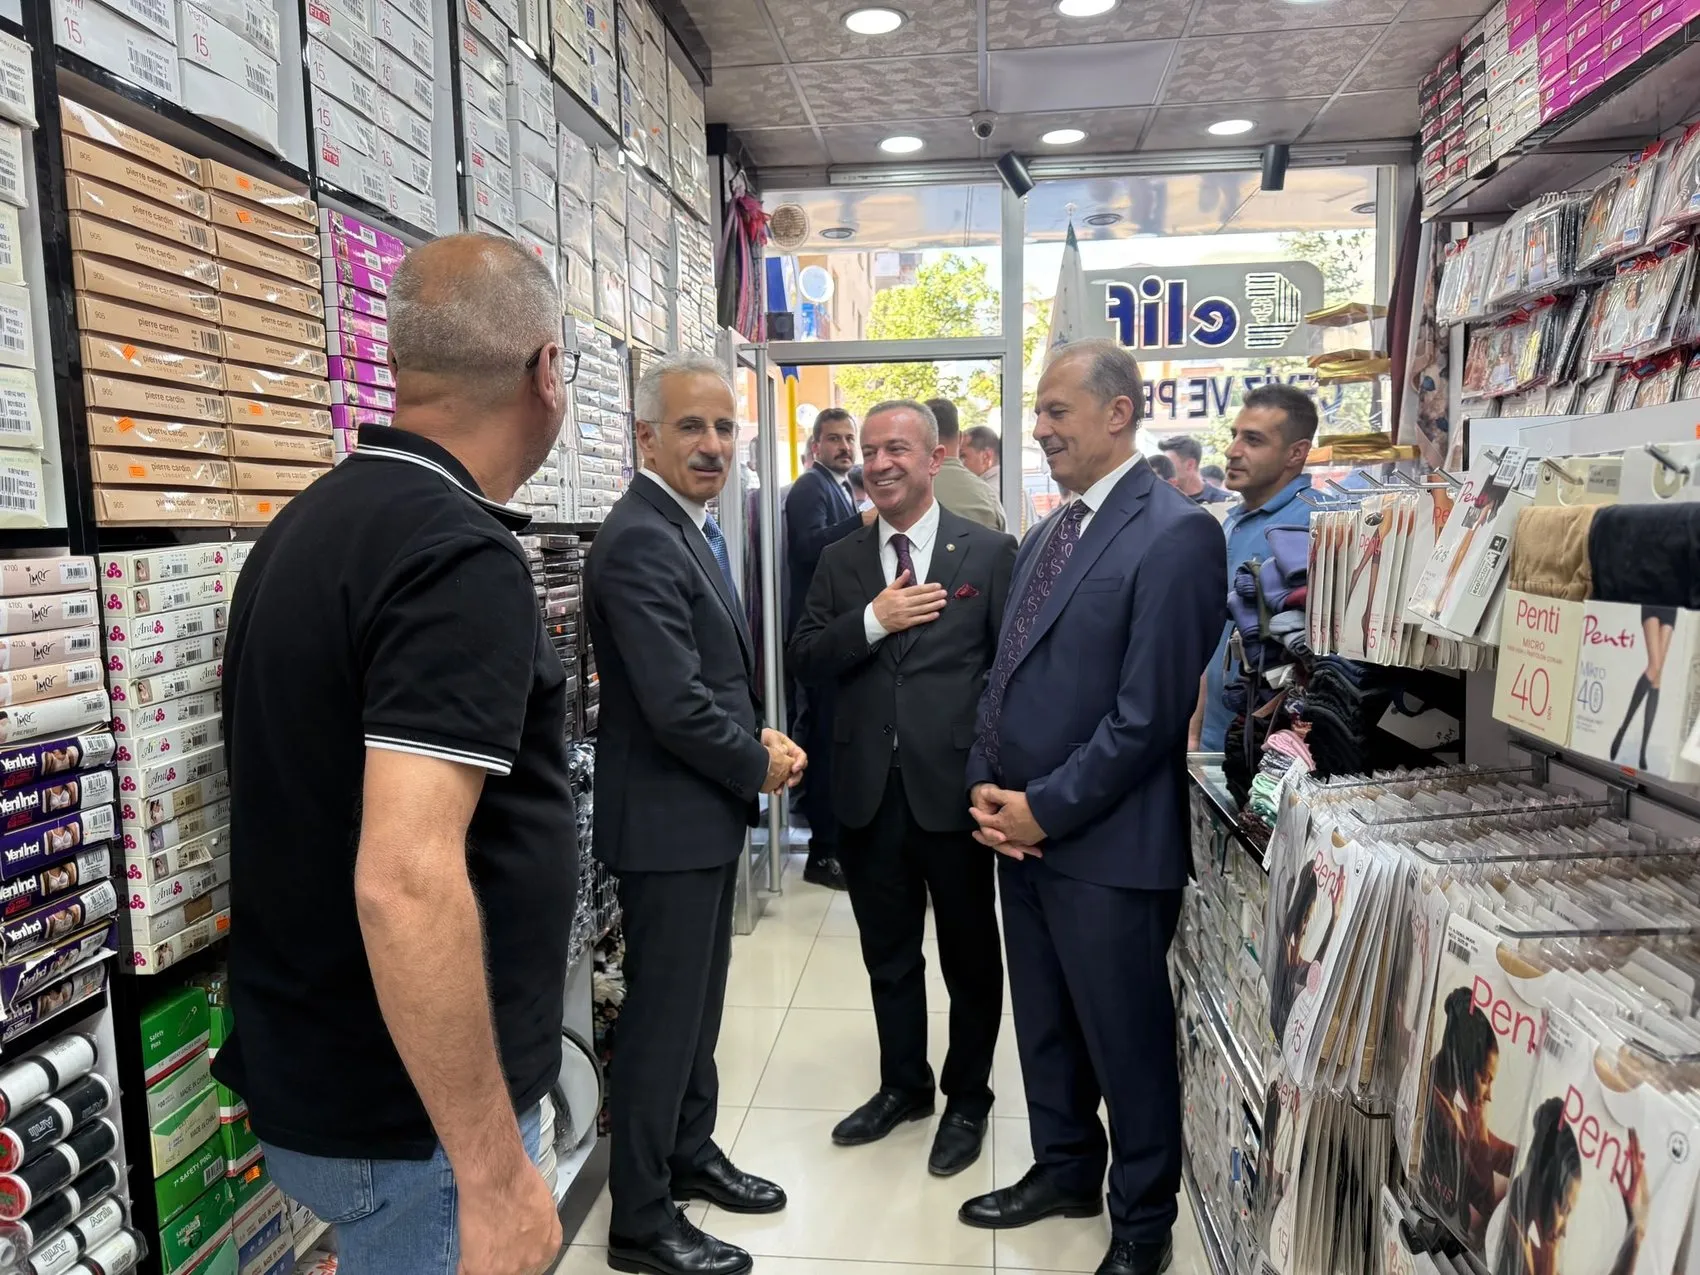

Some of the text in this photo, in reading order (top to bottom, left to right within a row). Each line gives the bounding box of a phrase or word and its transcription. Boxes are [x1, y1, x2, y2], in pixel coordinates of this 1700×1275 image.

[64, 16, 82, 44] 15
[382, 18, 391, 37] 15
[193, 33, 209, 57] 15
[314, 61, 325, 80] 15
[382, 63, 391, 81] 15
[317, 107, 331, 127] 15
[382, 150, 392, 167] 15
[126, 167, 168, 189] pierre cardin
[389, 194, 398, 210] 15
[132, 205, 174, 225] pierre cardin
[135, 242, 178, 261] pierre cardin
[138, 281, 180, 299] pierre cardin
[138, 317, 180, 334] pierre cardin
[260, 315, 292, 329] pierre cardin
[145, 391, 185, 404] pierre cardin
[147, 427, 189, 438] pierre cardin
[274, 440, 306, 449] pierre cardin
[151, 463, 192, 473] pierre cardin
[276, 472, 307, 480] pierre cardin
[4, 564, 18, 572] 4700
[8, 601, 23, 609] 4700
[1517, 598, 1561, 635] Penti
[1582, 614, 1636, 649] Penti
[12, 640, 26, 648] 4700
[1522, 637, 1546, 652] MICRO
[12, 673, 28, 682] 4700
[1511, 663, 1550, 716] 40
[1577, 679, 1604, 715] 40
[149, 1030, 164, 1042] Safety
[1292, 1018, 1305, 1054] 15
[151, 1041, 161, 1050] Pins
[180, 1084, 192, 1098] MADE
[190, 1126, 202, 1139] MADE
[179, 1163, 201, 1183] SAFETY
[200, 1152, 213, 1166] PINS
[258, 1213, 268, 1224] MADE
[1277, 1224, 1288, 1259] 15
[263, 1254, 273, 1266] MADE
